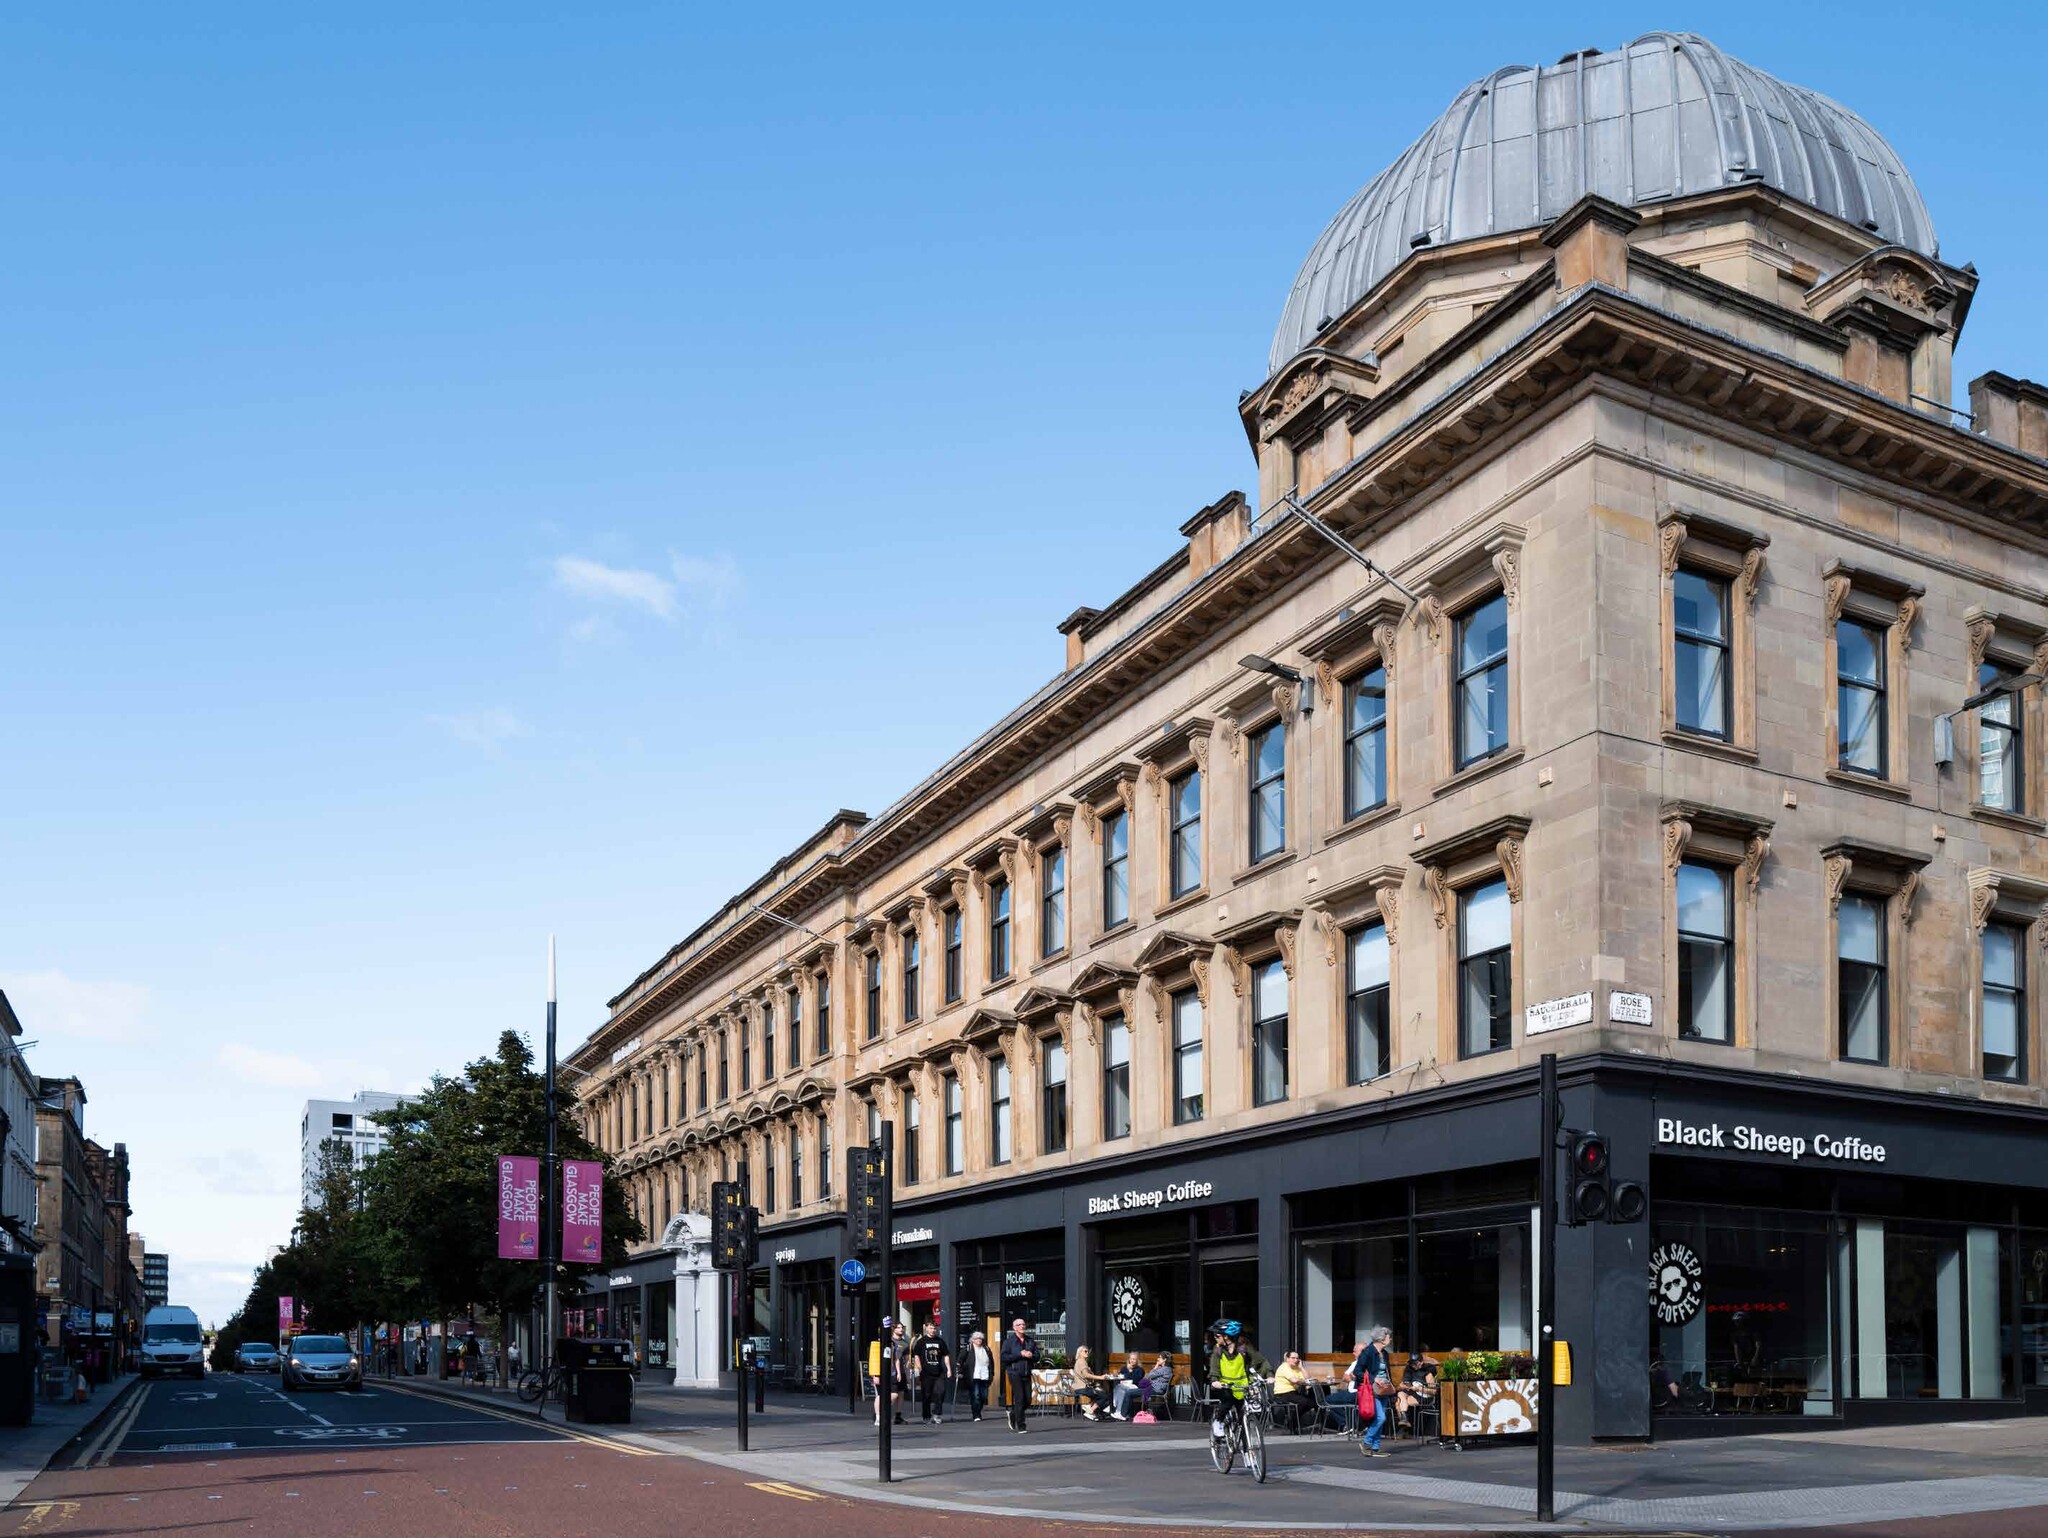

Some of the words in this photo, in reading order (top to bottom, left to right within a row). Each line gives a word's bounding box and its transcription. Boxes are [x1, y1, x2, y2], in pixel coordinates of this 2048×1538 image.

[1615, 1006, 1648, 1019] STREET
[1620, 996, 1643, 1008] ROSE
[1658, 1118, 1725, 1148] Black
[1733, 1126, 1806, 1160] Sheep
[1813, 1133, 1886, 1163] Coffee
[501, 1160, 513, 1221] GLASGOW
[513, 1188, 525, 1222] MAKE
[525, 1180, 537, 1223] PEOPLE
[566, 1165, 578, 1225] GLASGOW
[588, 1184, 600, 1227] PEOPLE
[1088, 1194, 1121, 1215] Black
[1123, 1190, 1163, 1208] Sheep
[1167, 1180, 1212, 1202] Coffee
[577, 1192, 589, 1226] MAKE
[775, 1247, 796, 1263] sprigg
[1648, 1245, 1669, 1290] BLACK
[1670, 1243, 1702, 1277] SHEEP
[1005, 1271, 1035, 1285] McLellan
[1005, 1285, 1027, 1297] Works
[1113, 1280, 1125, 1314] BLACK
[1123, 1276, 1143, 1297] SHEEP
[1121, 1307, 1144, 1333] COFFEE
[1657, 1291, 1701, 1324] COFFEE
